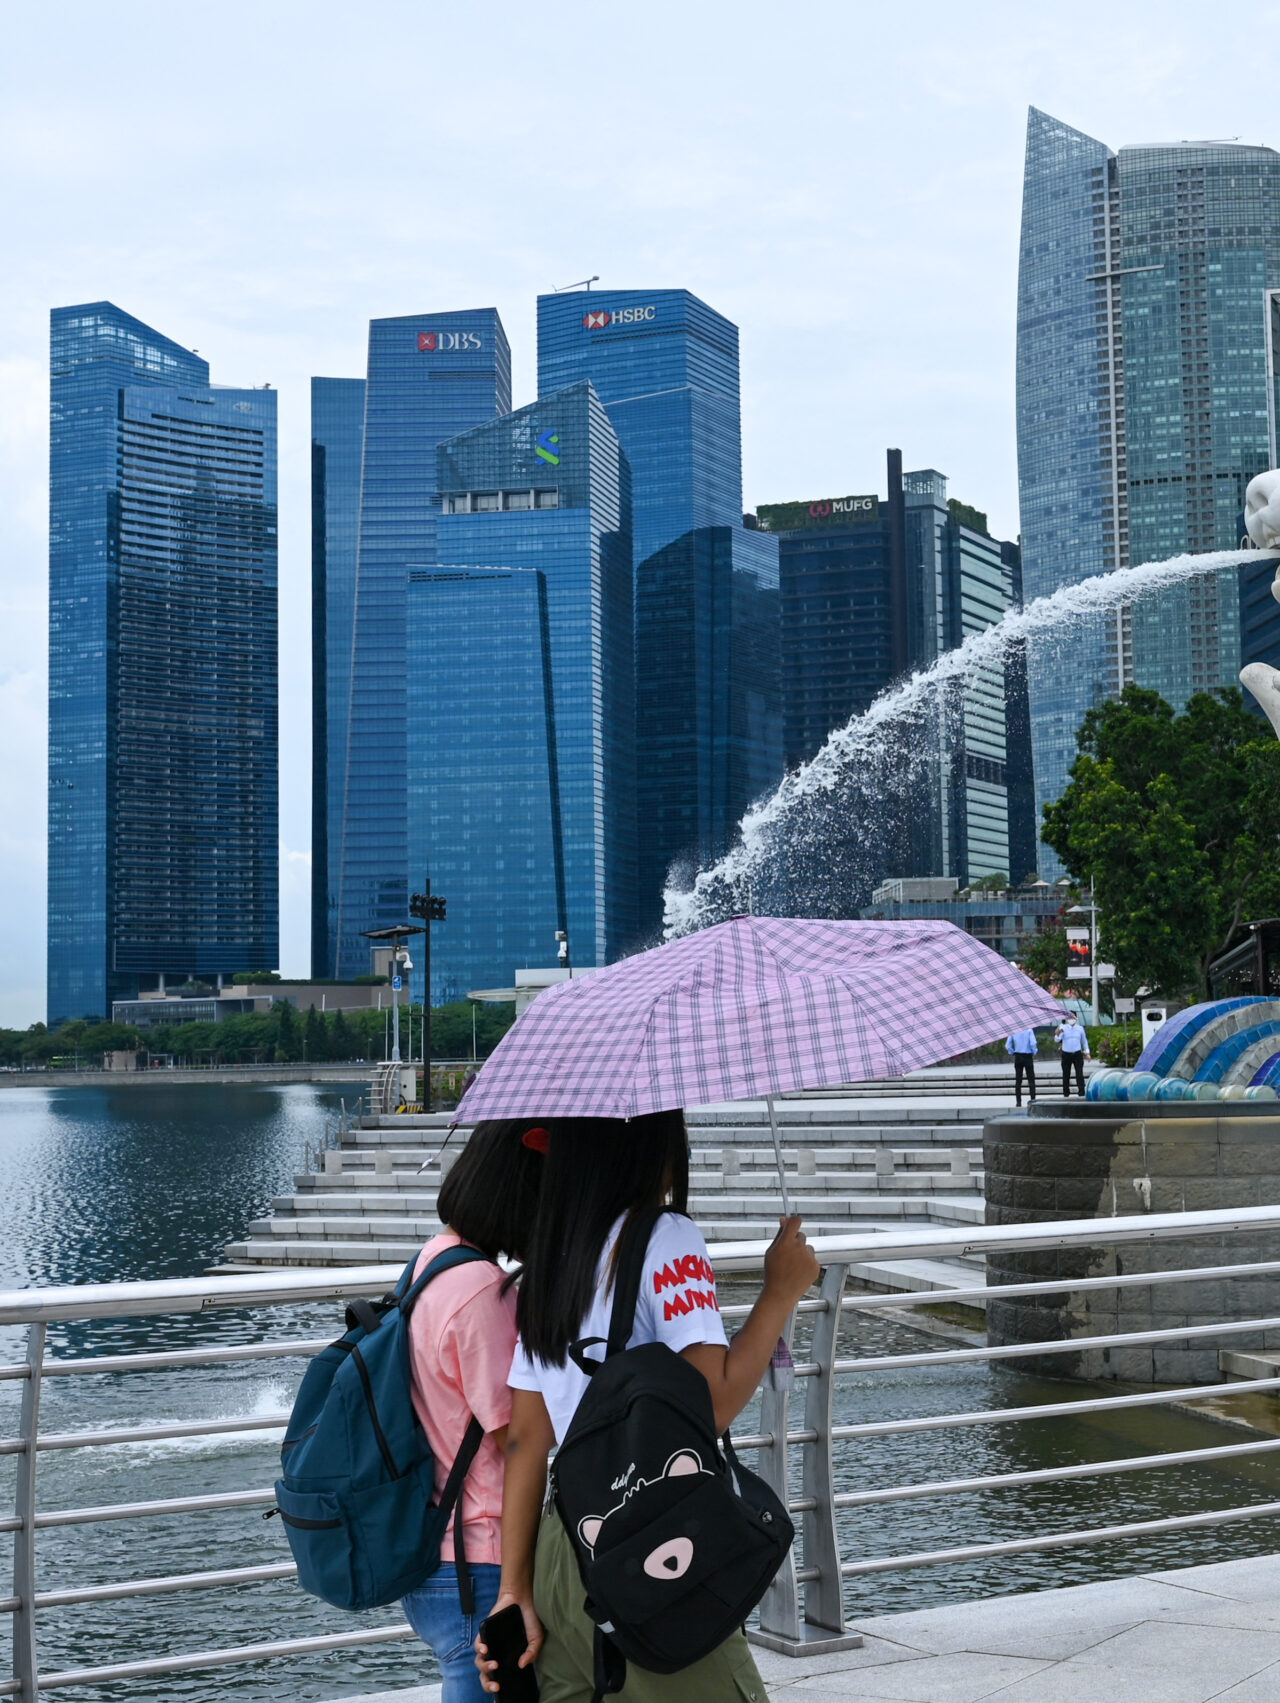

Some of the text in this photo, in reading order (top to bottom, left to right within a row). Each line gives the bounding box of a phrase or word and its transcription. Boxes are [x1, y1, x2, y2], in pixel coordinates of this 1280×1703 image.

[611, 305, 656, 325] HSBC
[438, 332, 482, 350] DBS
[832, 498, 873, 513] MUFG
